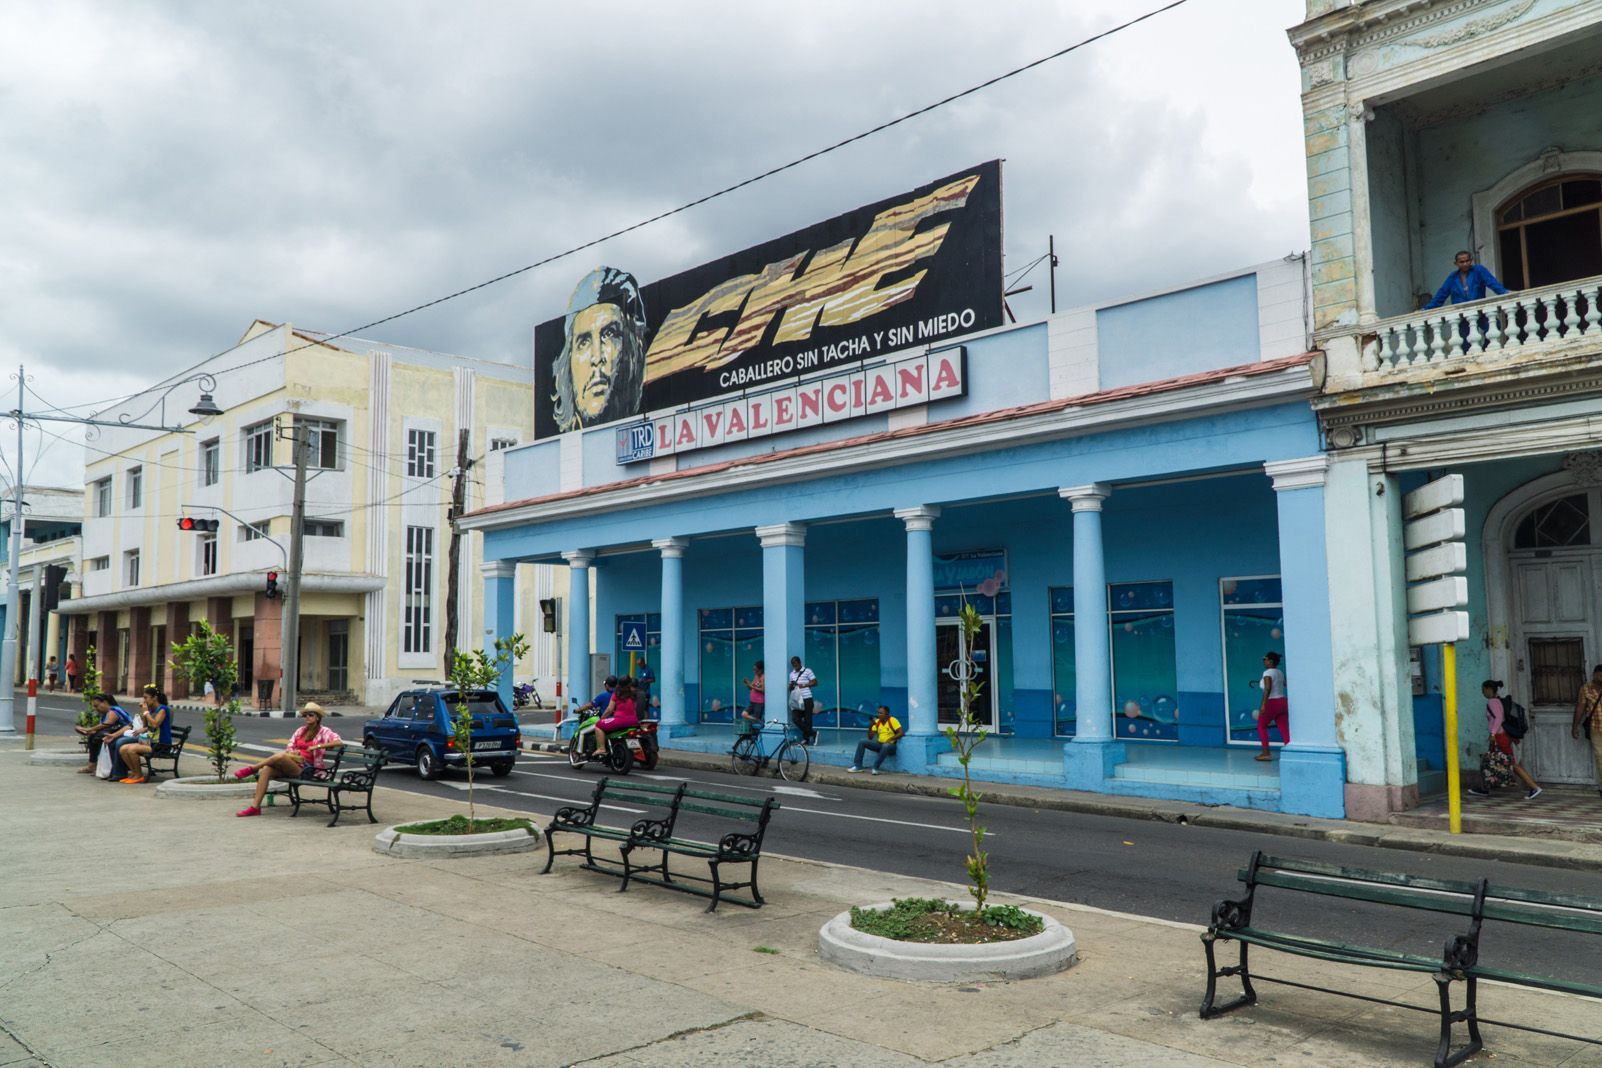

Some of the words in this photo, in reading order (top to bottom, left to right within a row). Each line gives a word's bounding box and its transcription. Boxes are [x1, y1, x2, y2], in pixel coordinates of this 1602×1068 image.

[643, 174, 982, 385] CHE
[720, 356, 794, 387] CABALLERO
[797, 350, 819, 370] SIN
[822, 335, 869, 362] TACHA
[874, 331, 884, 350] Y
[888, 326, 914, 346] SIN
[919, 308, 976, 339] MIEDO
[632, 425, 653, 448] TRD
[658, 419, 696, 449] LA
[704, 358, 960, 438] VALENCIANA
[632, 448, 652, 460] CARIBE
